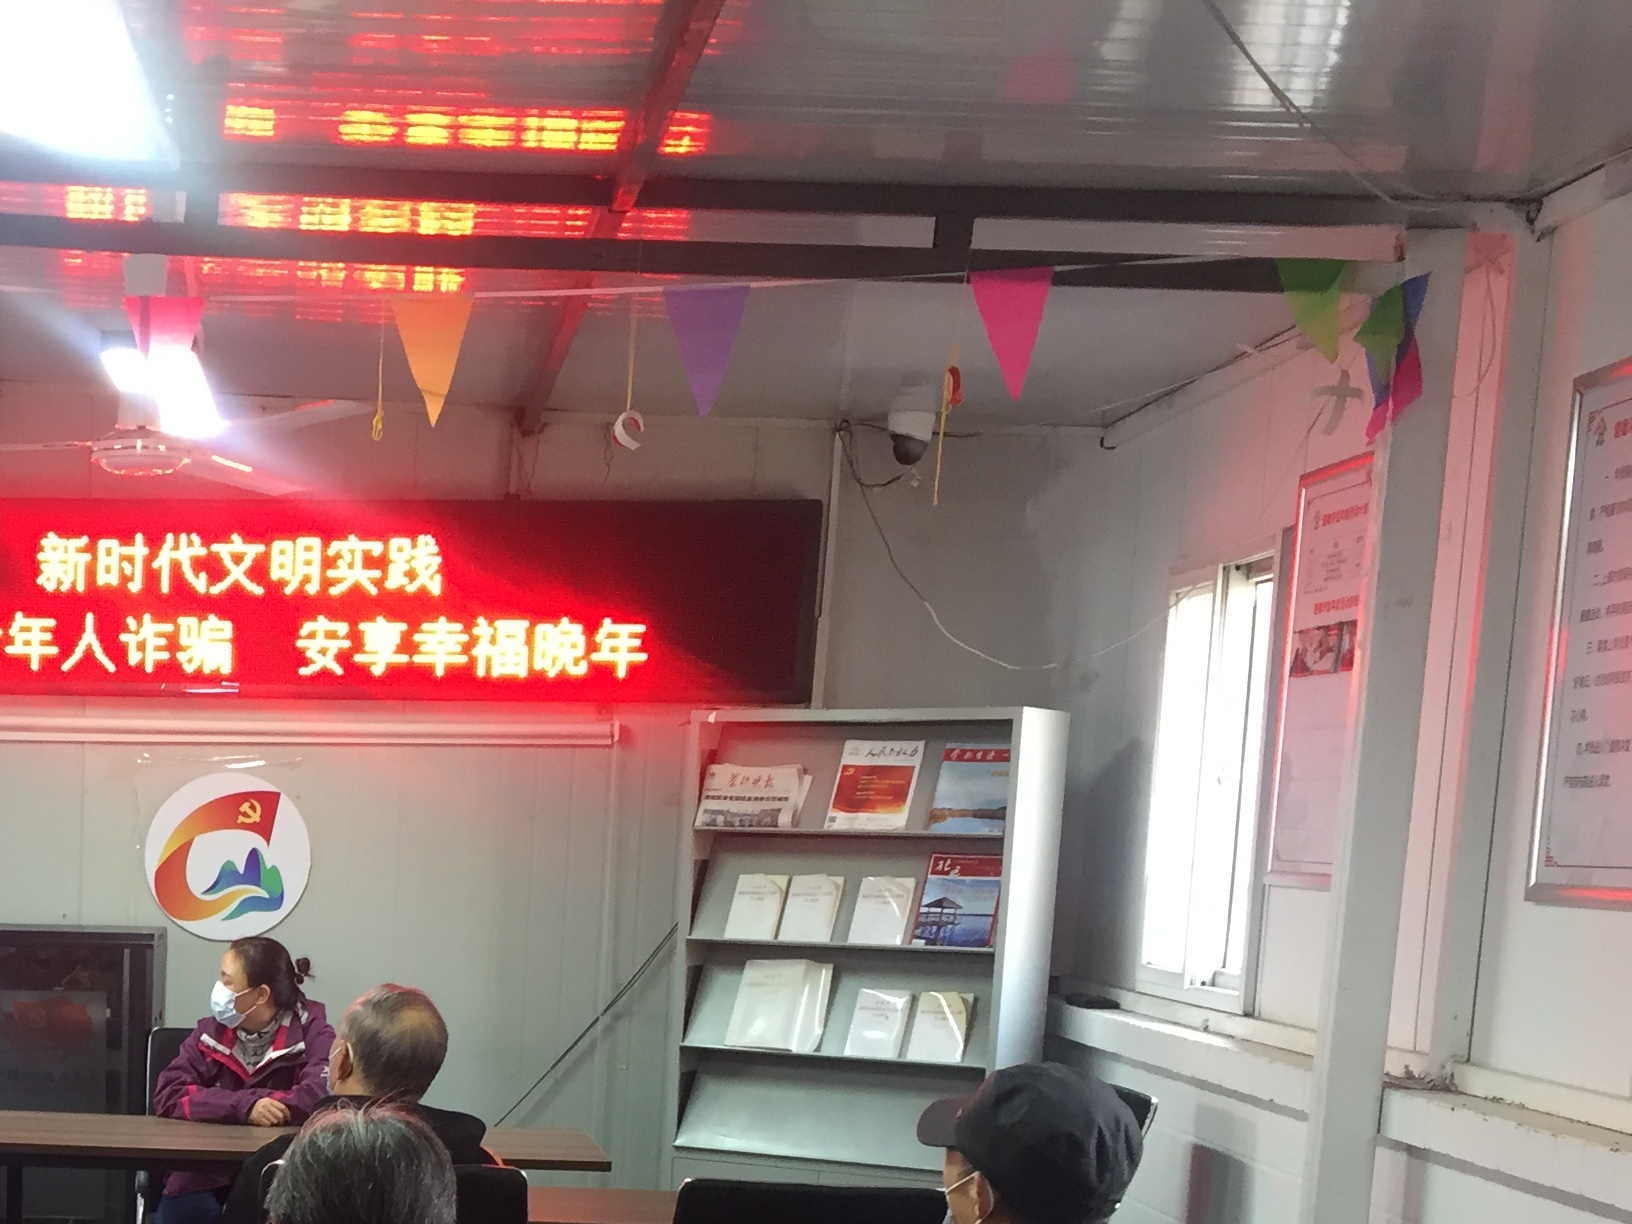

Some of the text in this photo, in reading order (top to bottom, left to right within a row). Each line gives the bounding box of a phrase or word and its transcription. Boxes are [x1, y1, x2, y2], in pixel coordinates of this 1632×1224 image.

[35, 530, 444, 597] 新时代文明实践
[295, 614, 650, 680] 安享幸福晚年
